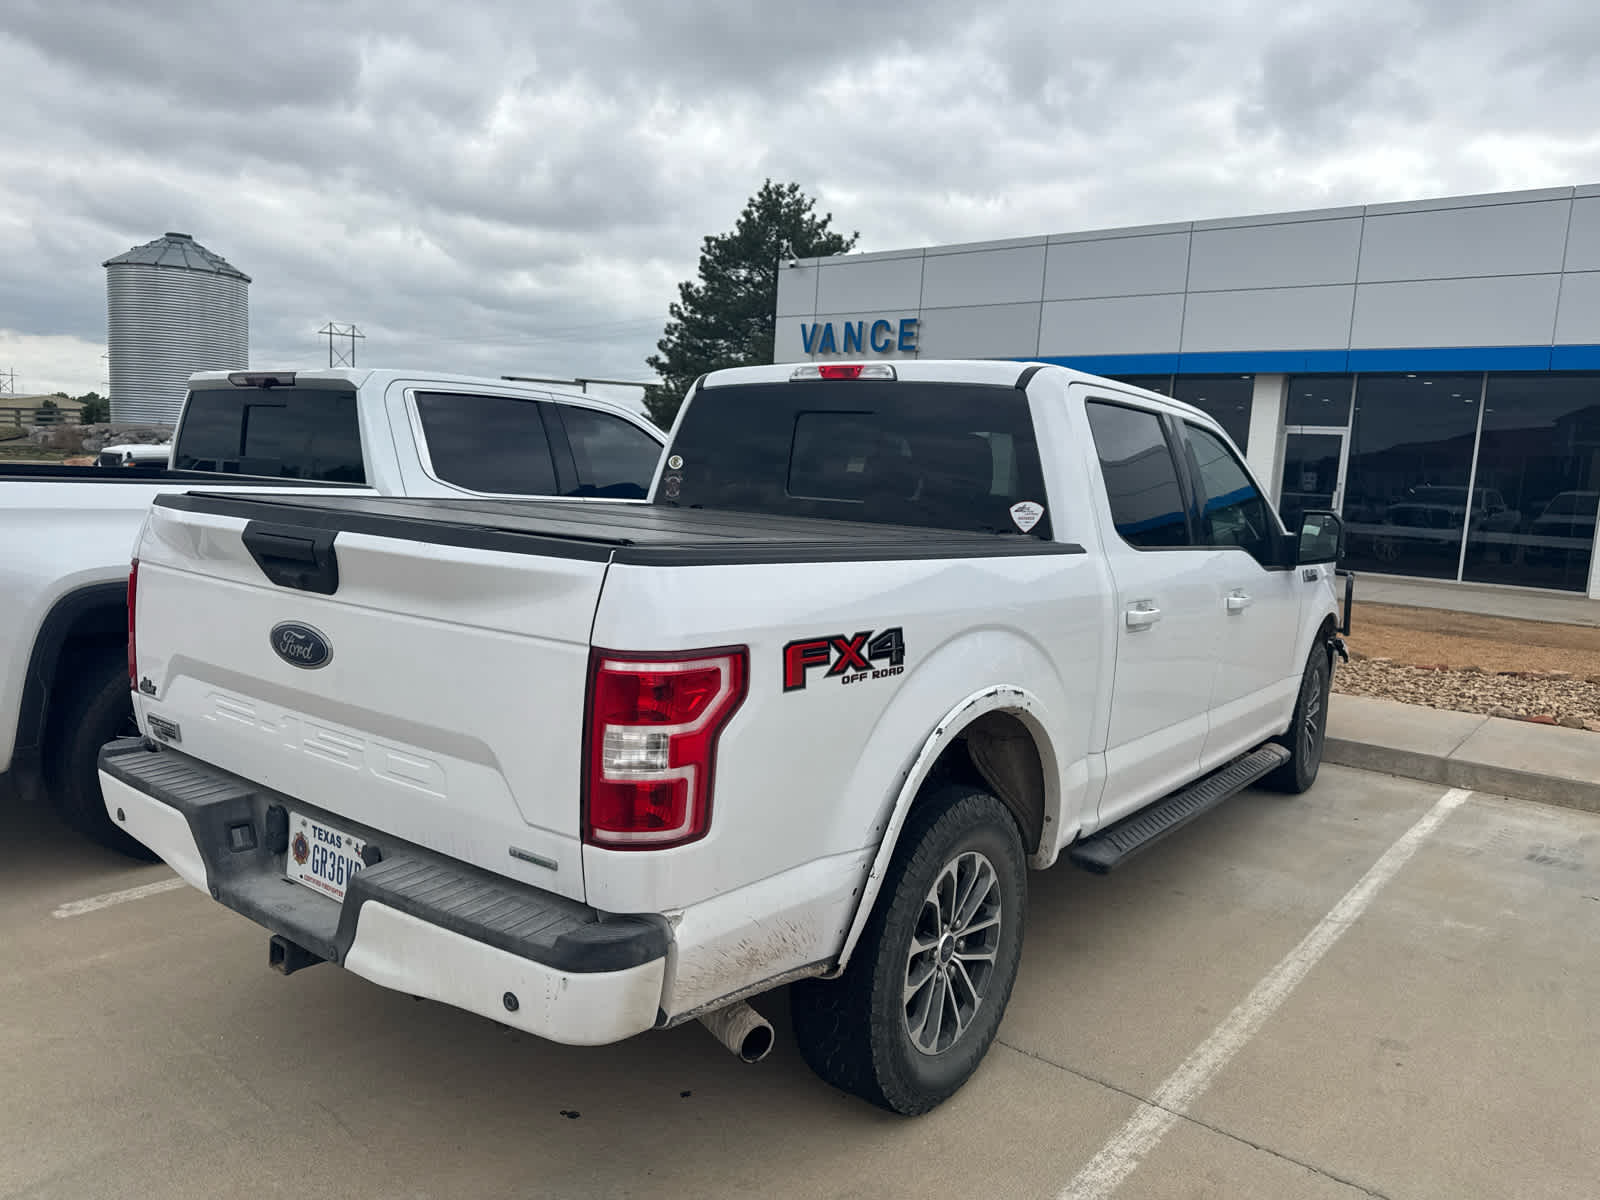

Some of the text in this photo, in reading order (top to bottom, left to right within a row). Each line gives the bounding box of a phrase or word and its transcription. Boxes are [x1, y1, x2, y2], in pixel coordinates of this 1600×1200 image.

[800, 318, 918, 353] VANCE
[278, 629, 313, 660] Ford
[782, 626, 905, 692] FX4
[841, 666, 904, 685] OFF ROAD
[311, 825, 342, 849] TEXAS
